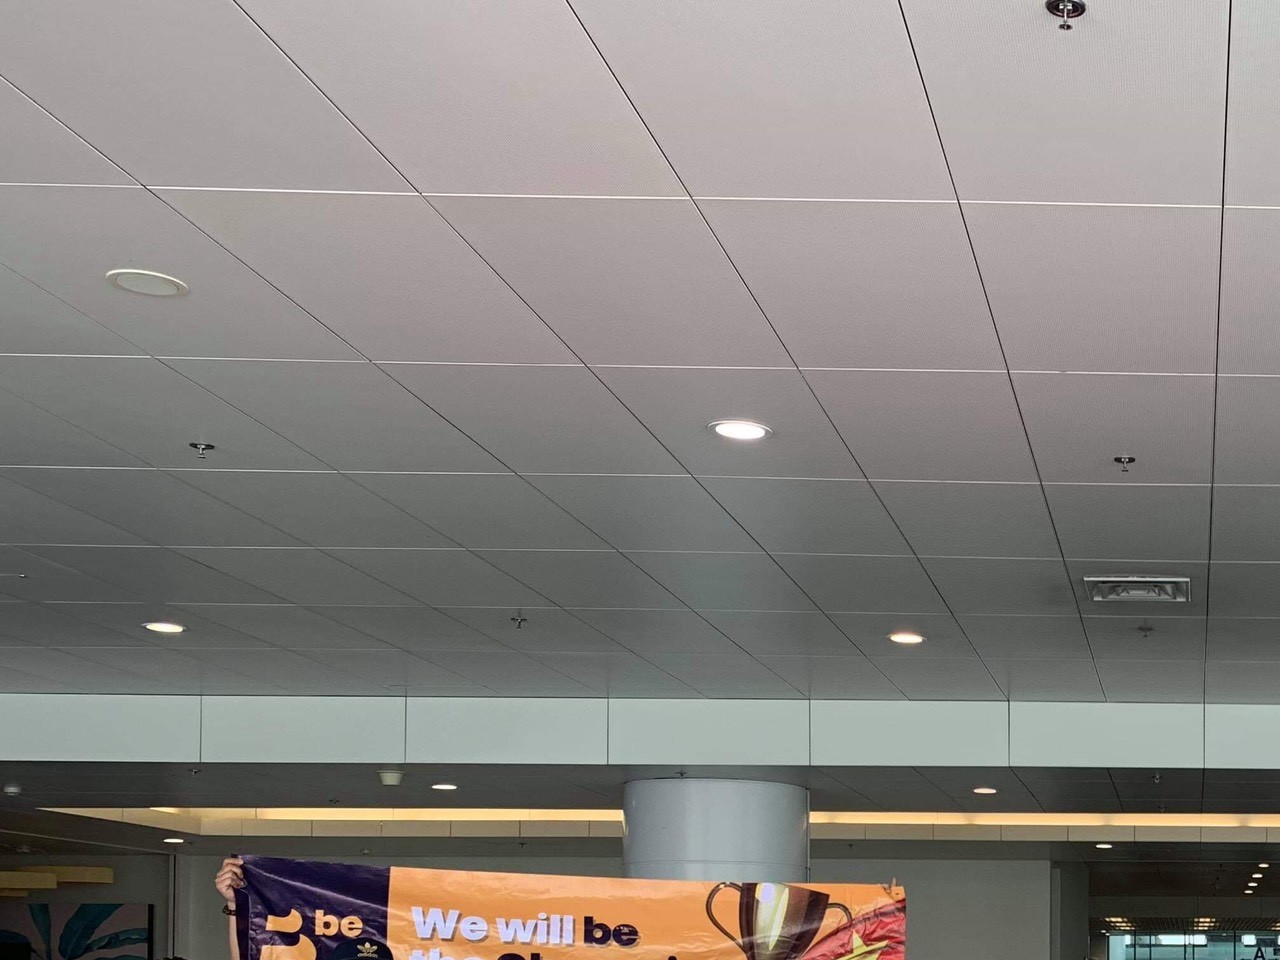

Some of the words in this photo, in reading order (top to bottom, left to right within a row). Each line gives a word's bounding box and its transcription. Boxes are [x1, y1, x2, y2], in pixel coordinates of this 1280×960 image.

[314, 910, 363, 936] be
[411, 906, 489, 942] We
[497, 912, 575, 945] will
[584, 916, 640, 947] be
